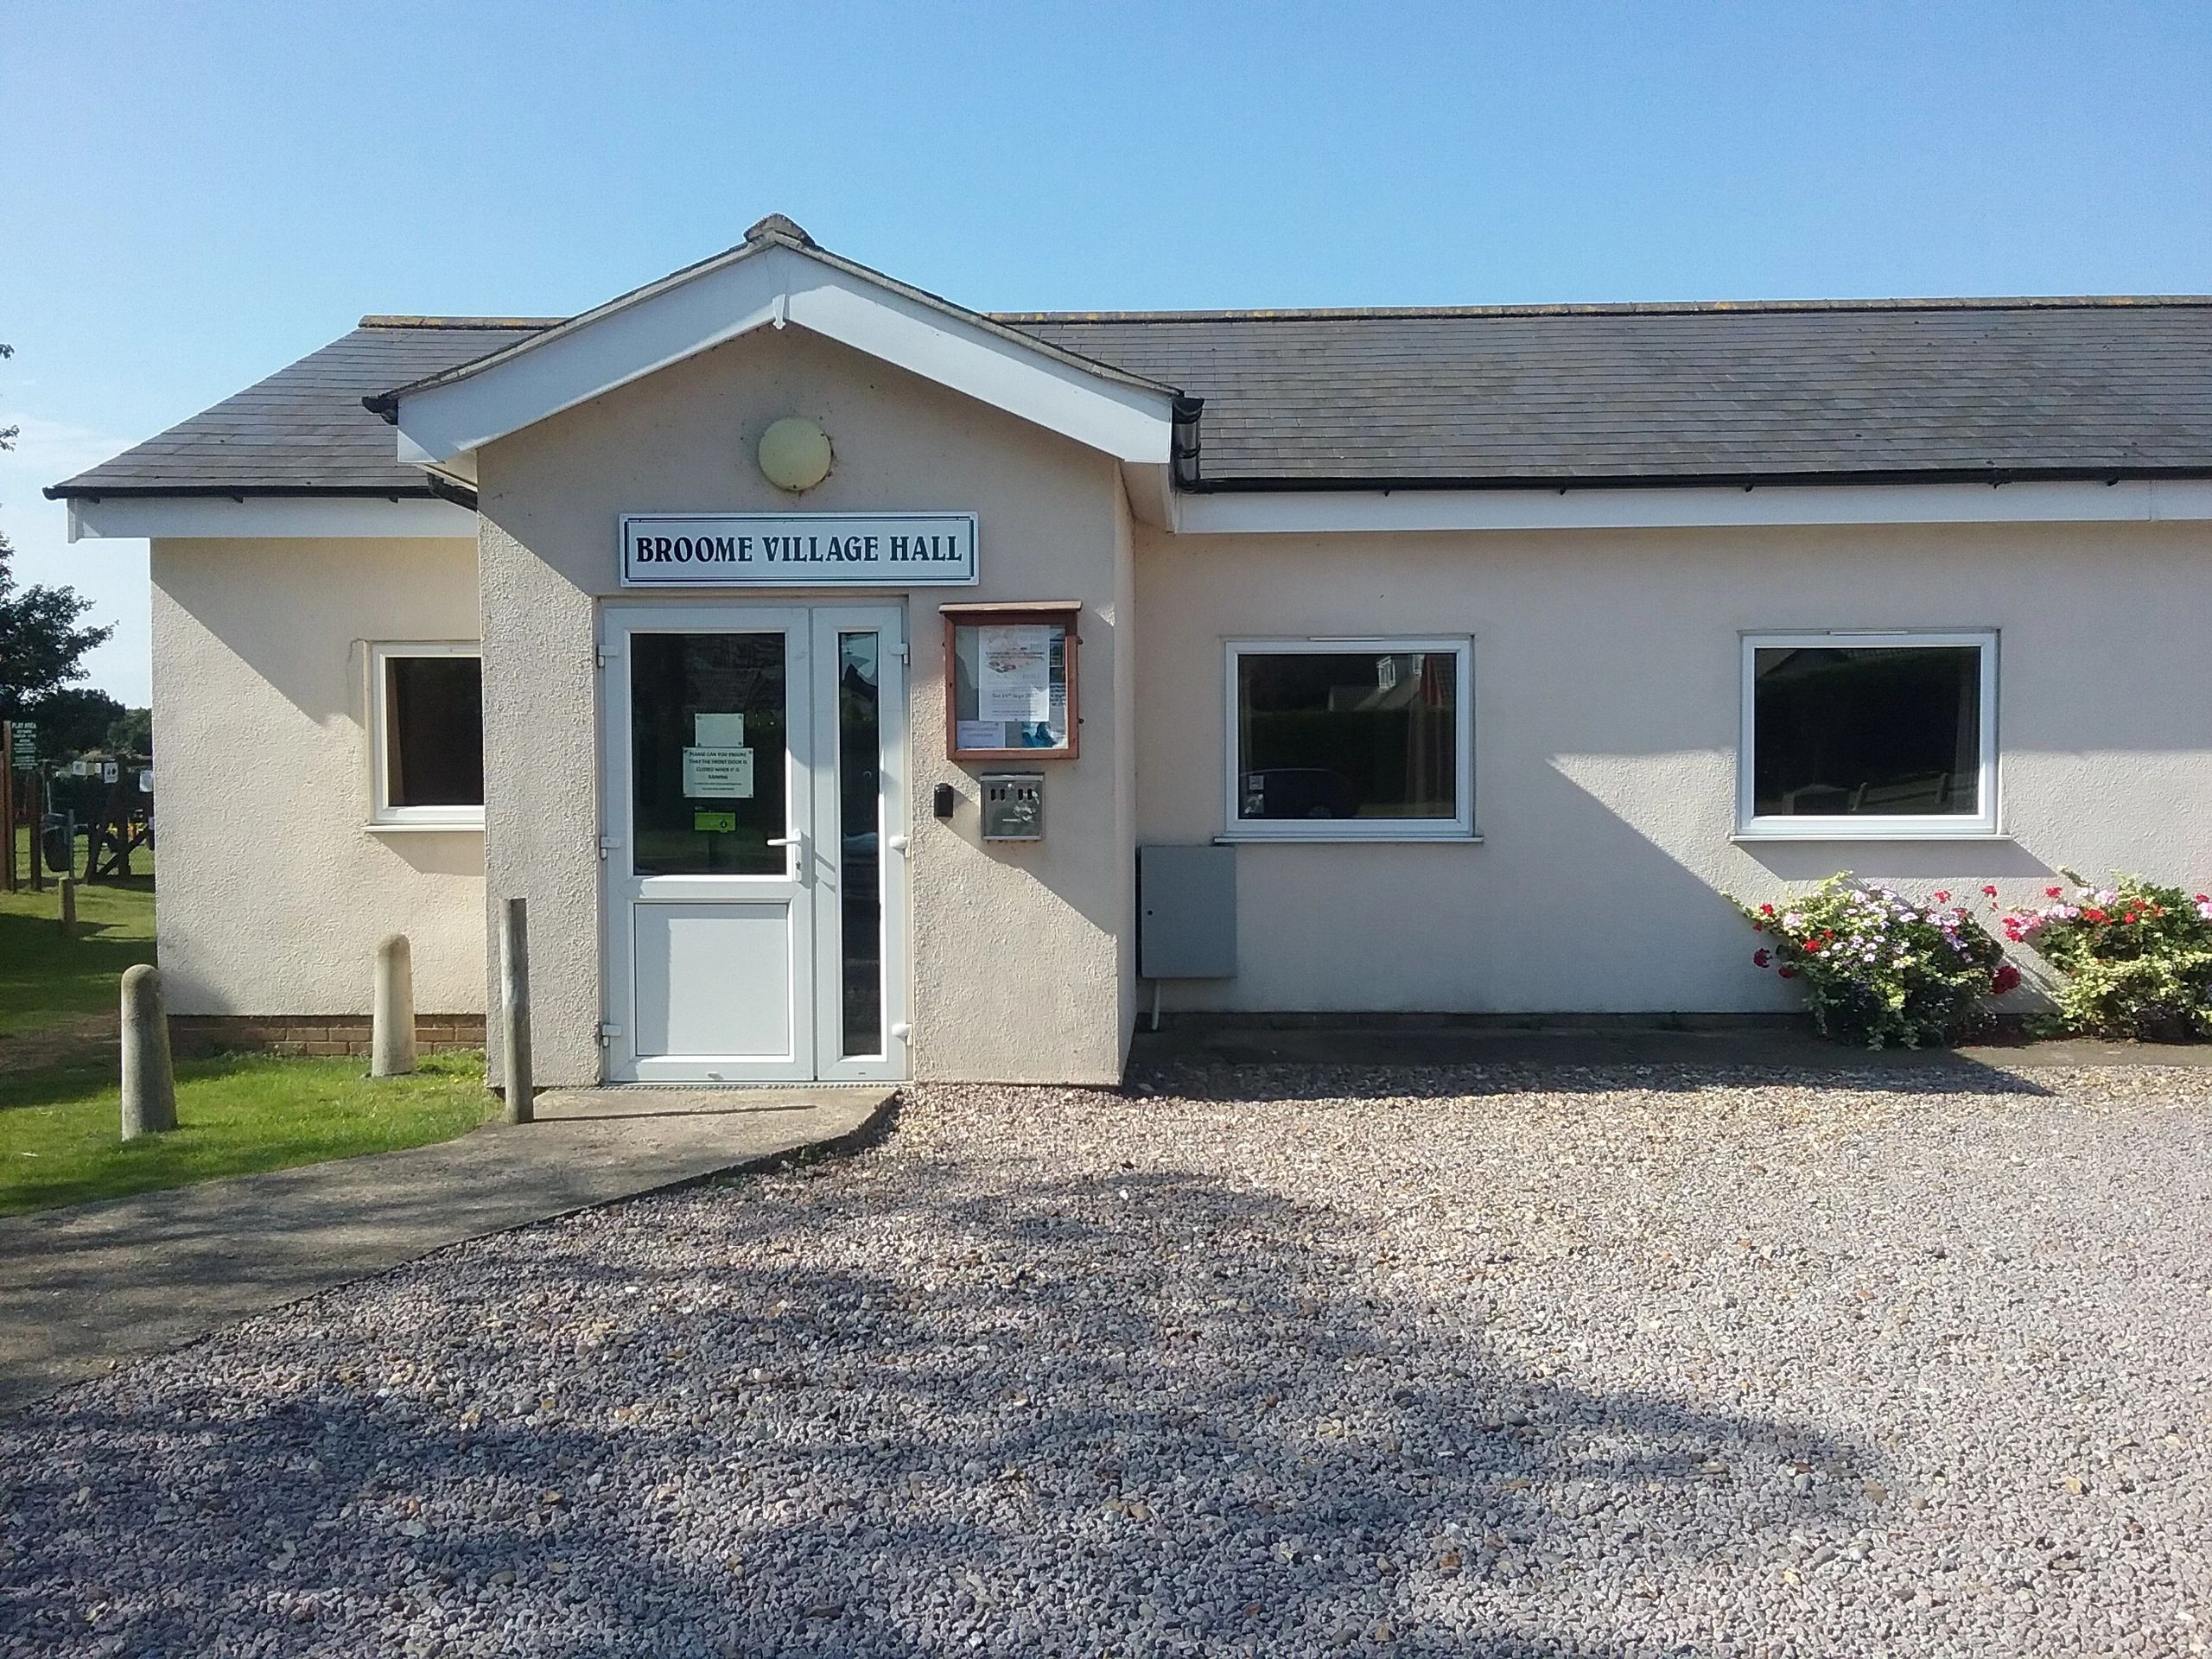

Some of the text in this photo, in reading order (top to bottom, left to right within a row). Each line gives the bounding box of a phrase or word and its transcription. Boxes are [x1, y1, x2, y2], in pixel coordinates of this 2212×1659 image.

[636, 536, 962, 563] BROOME VILLAGE HALL
